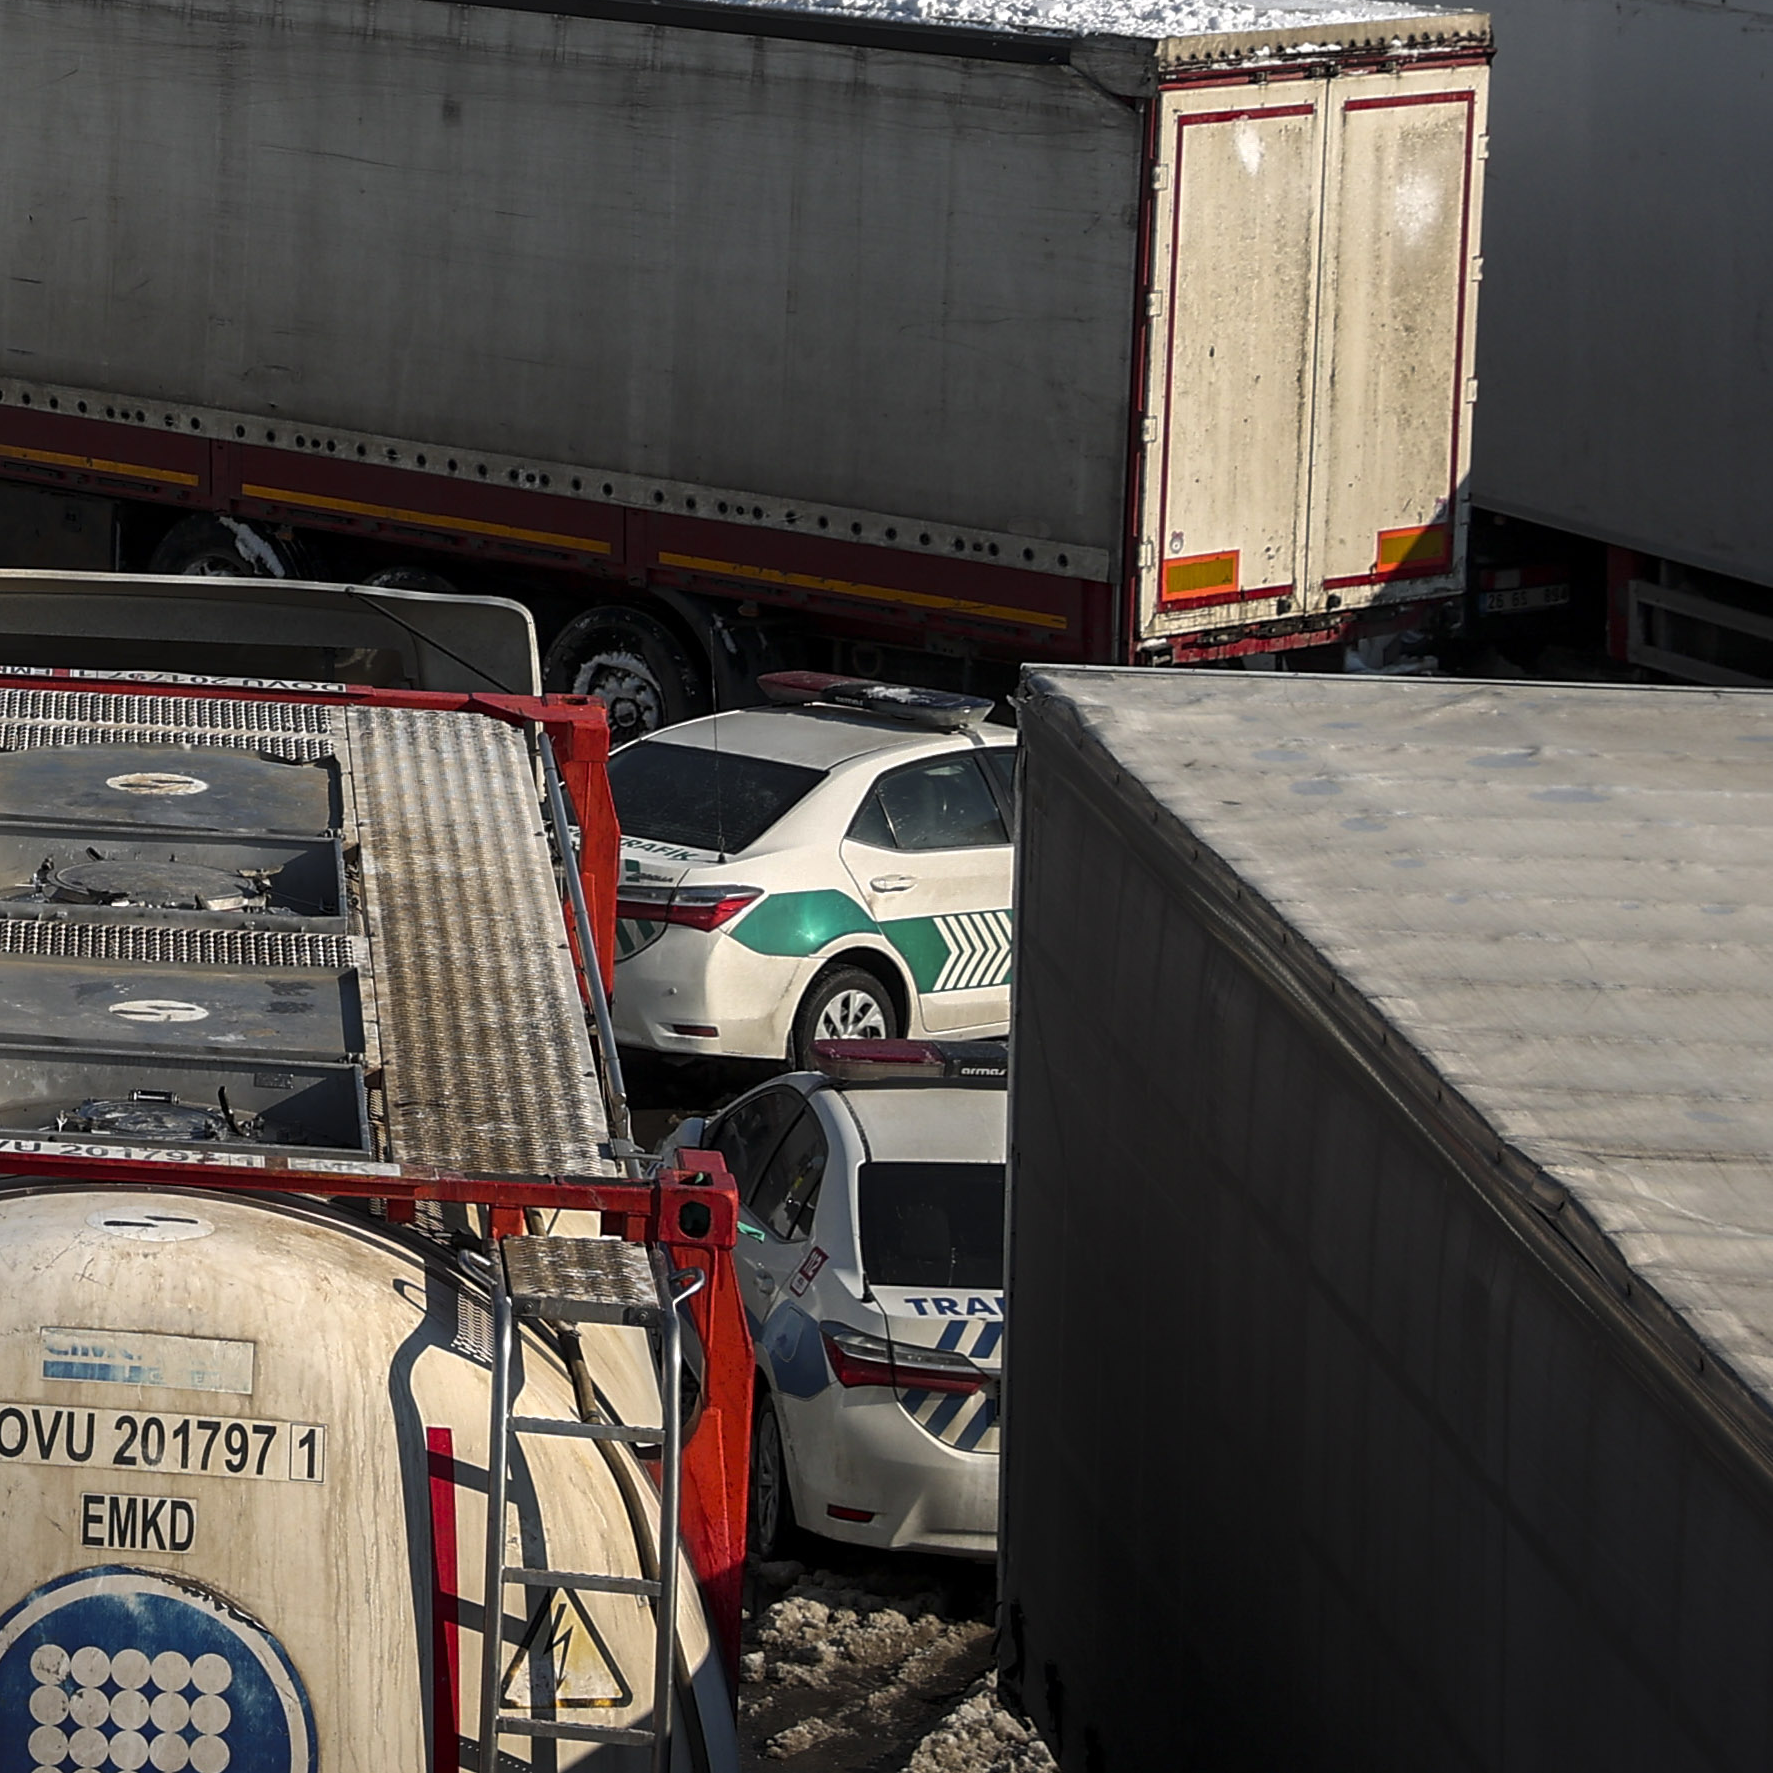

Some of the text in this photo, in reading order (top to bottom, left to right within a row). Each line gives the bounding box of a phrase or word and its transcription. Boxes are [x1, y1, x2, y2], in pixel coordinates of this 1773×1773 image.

[112, 1415, 277, 1476] 201797
[297, 1429, 318, 1480] 1
[81, 1494, 195, 1553] EMKD
